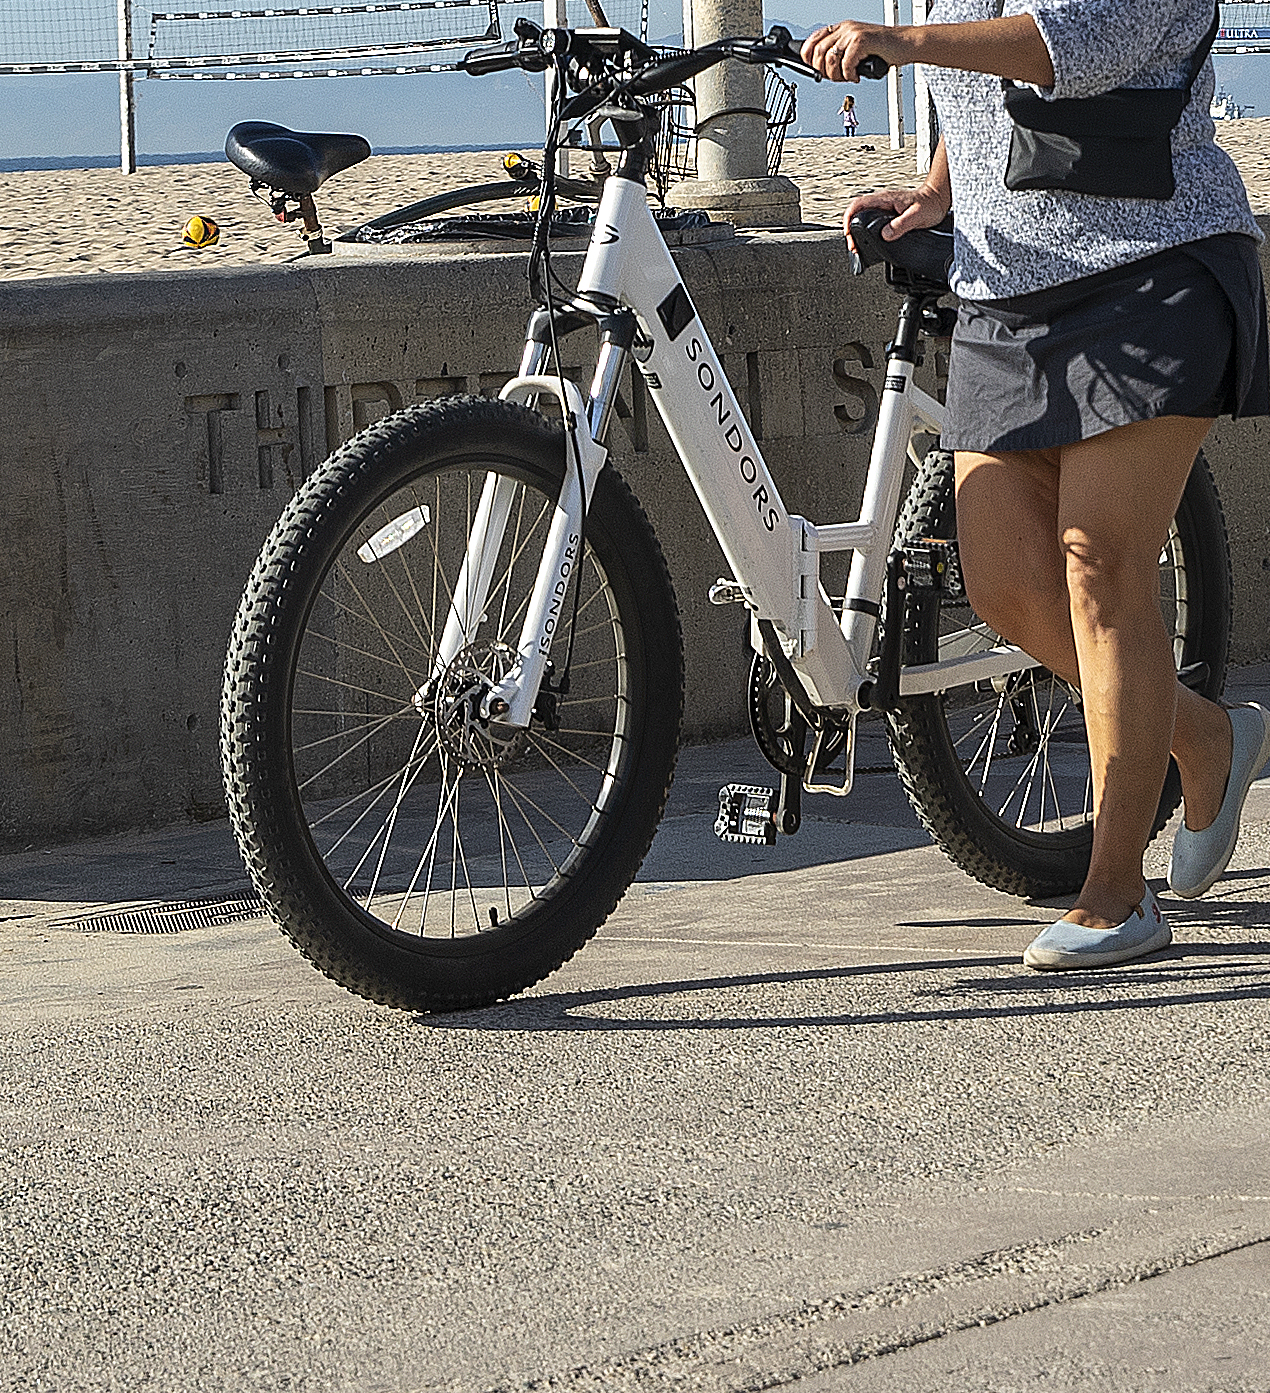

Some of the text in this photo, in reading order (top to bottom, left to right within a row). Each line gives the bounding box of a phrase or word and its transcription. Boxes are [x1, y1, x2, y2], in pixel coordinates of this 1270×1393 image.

[1226, 29, 1258, 38] ULTRA
[686, 338, 779, 531] SONDORS
[541, 533, 579, 649] SONDORS
